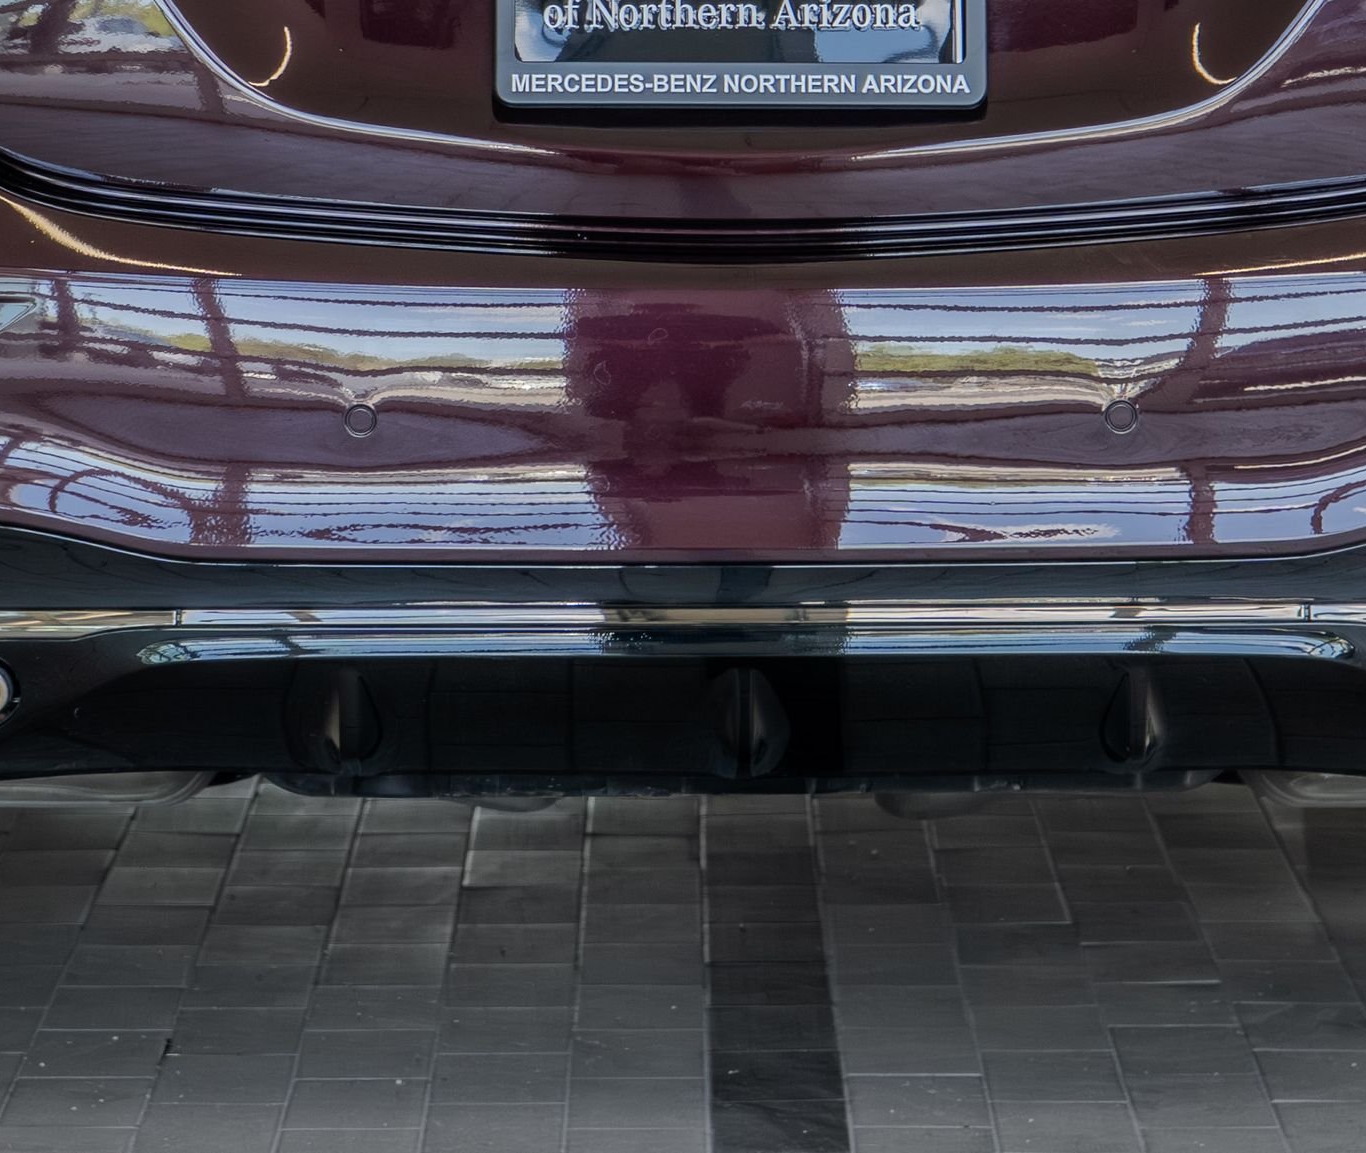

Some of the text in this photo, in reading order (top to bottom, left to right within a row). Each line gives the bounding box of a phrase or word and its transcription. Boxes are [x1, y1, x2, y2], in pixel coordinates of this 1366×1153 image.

[511, 74, 971, 94] MERCEDES-BENZ NORTHERN ARIZONA
